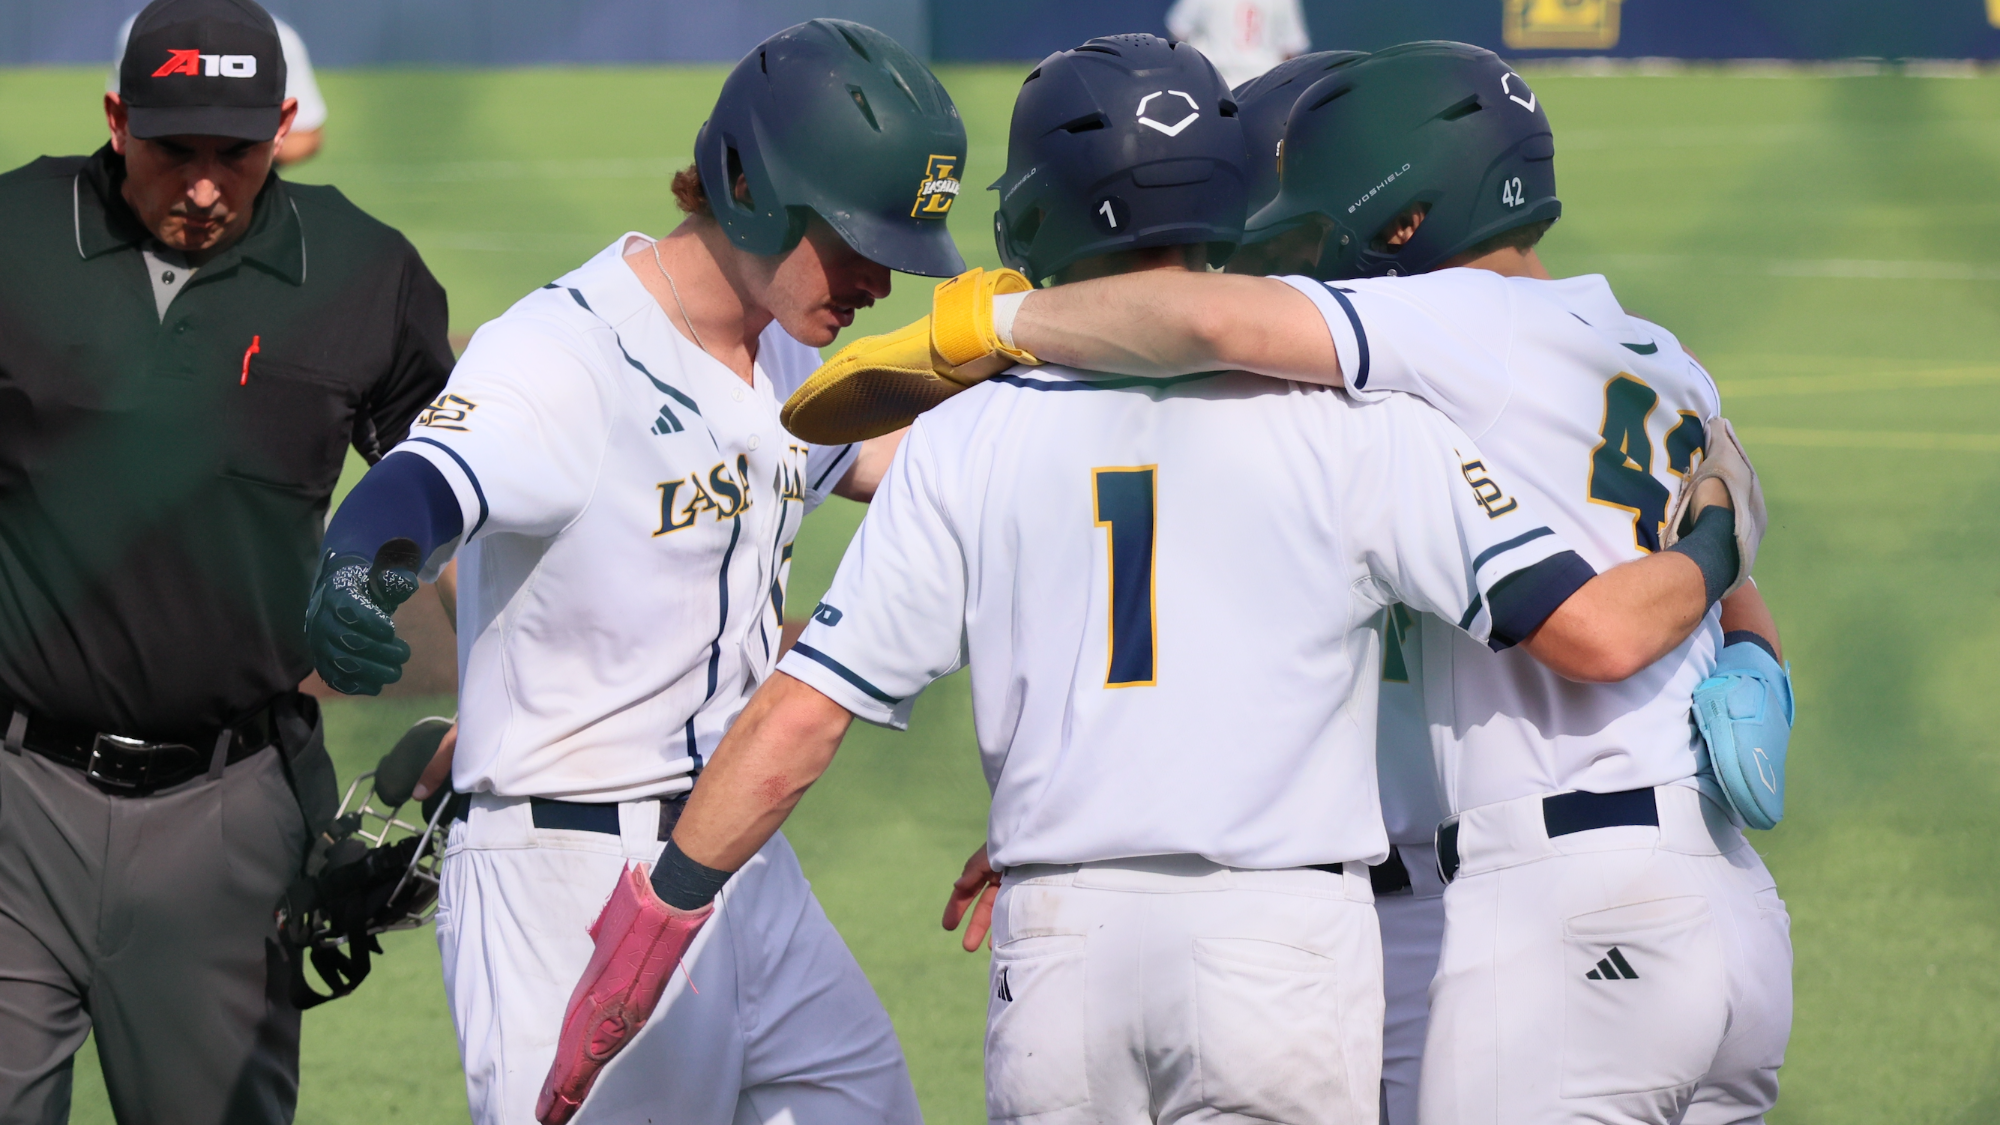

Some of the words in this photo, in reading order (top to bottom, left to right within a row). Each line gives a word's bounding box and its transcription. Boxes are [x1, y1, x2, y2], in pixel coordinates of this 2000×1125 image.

[151, 49, 257, 78] A10
[1502, 176, 1525, 207] 42
[1099, 200, 1117, 228] 1
[1091, 463, 1158, 689] 1
